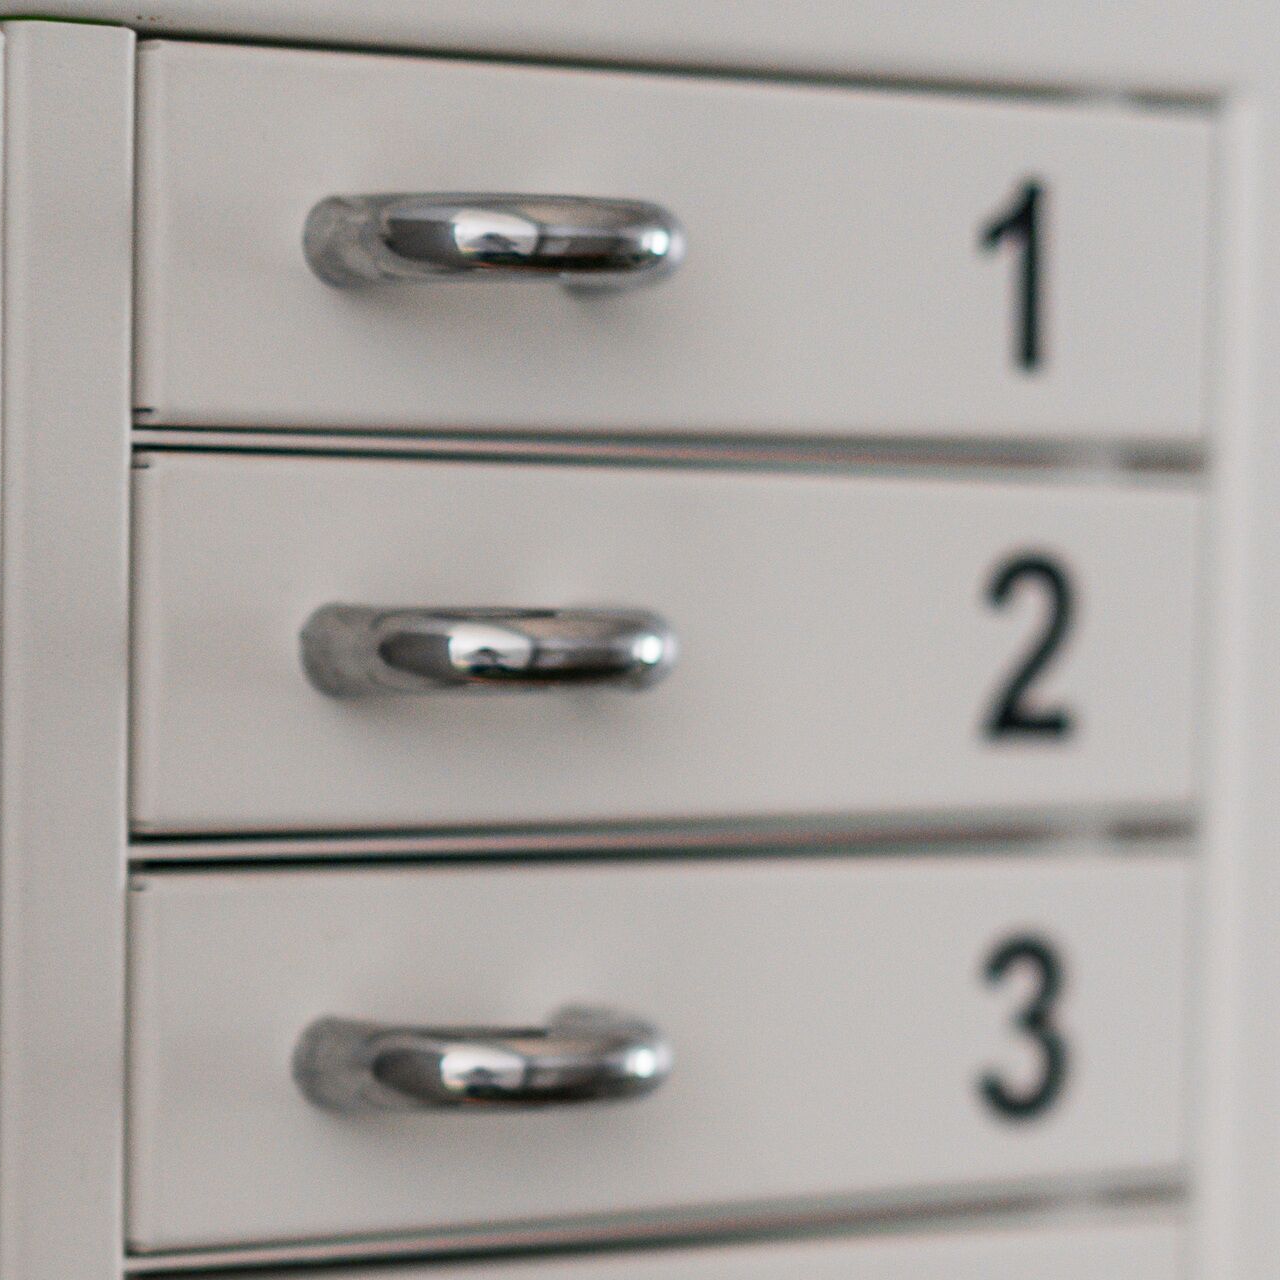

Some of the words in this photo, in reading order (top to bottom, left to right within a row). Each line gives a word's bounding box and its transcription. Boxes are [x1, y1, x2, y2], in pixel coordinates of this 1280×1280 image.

[977, 176, 1049, 376] 1
[979, 548, 1080, 747] 2
[974, 929, 1074, 1129] 3
